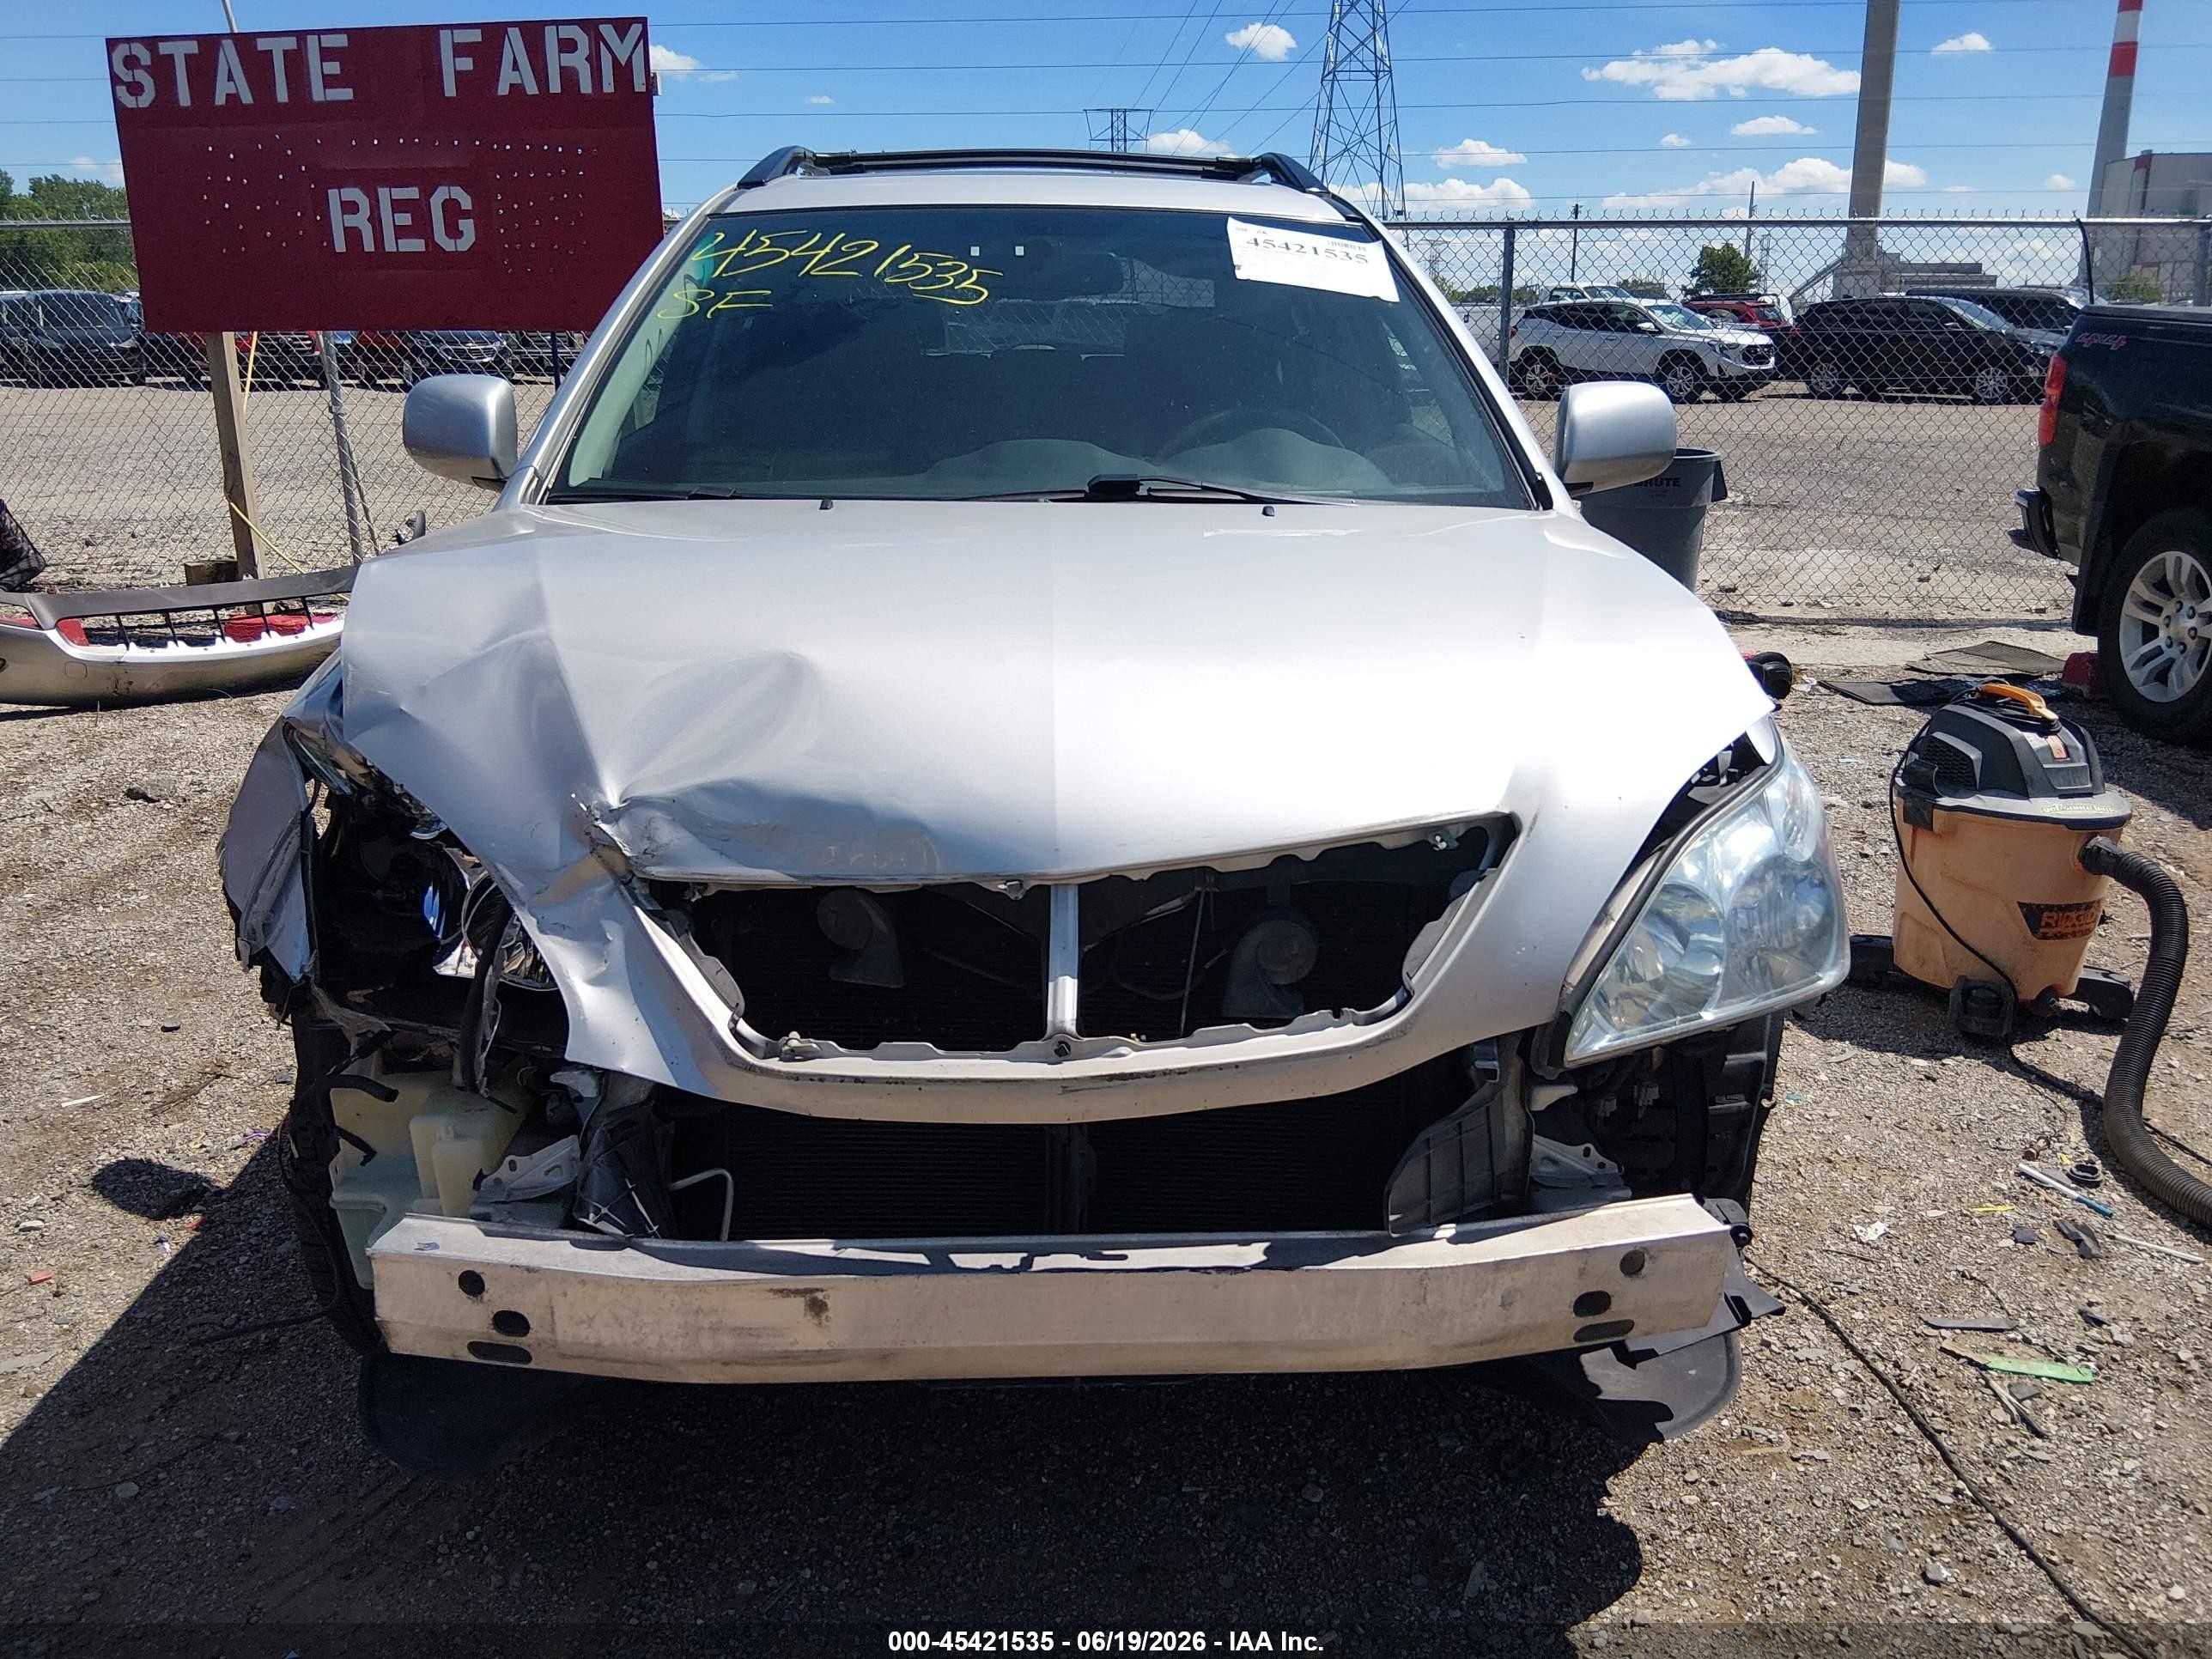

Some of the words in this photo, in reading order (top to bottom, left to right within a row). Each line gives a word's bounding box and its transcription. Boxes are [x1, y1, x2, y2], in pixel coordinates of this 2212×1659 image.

[112, 34, 354, 108] STATE
[439, 23, 647, 97] FARM
[327, 185, 477, 253] REG
[1246, 236, 1369, 265] 45421535
[690, 228, 1004, 306] 45421535
